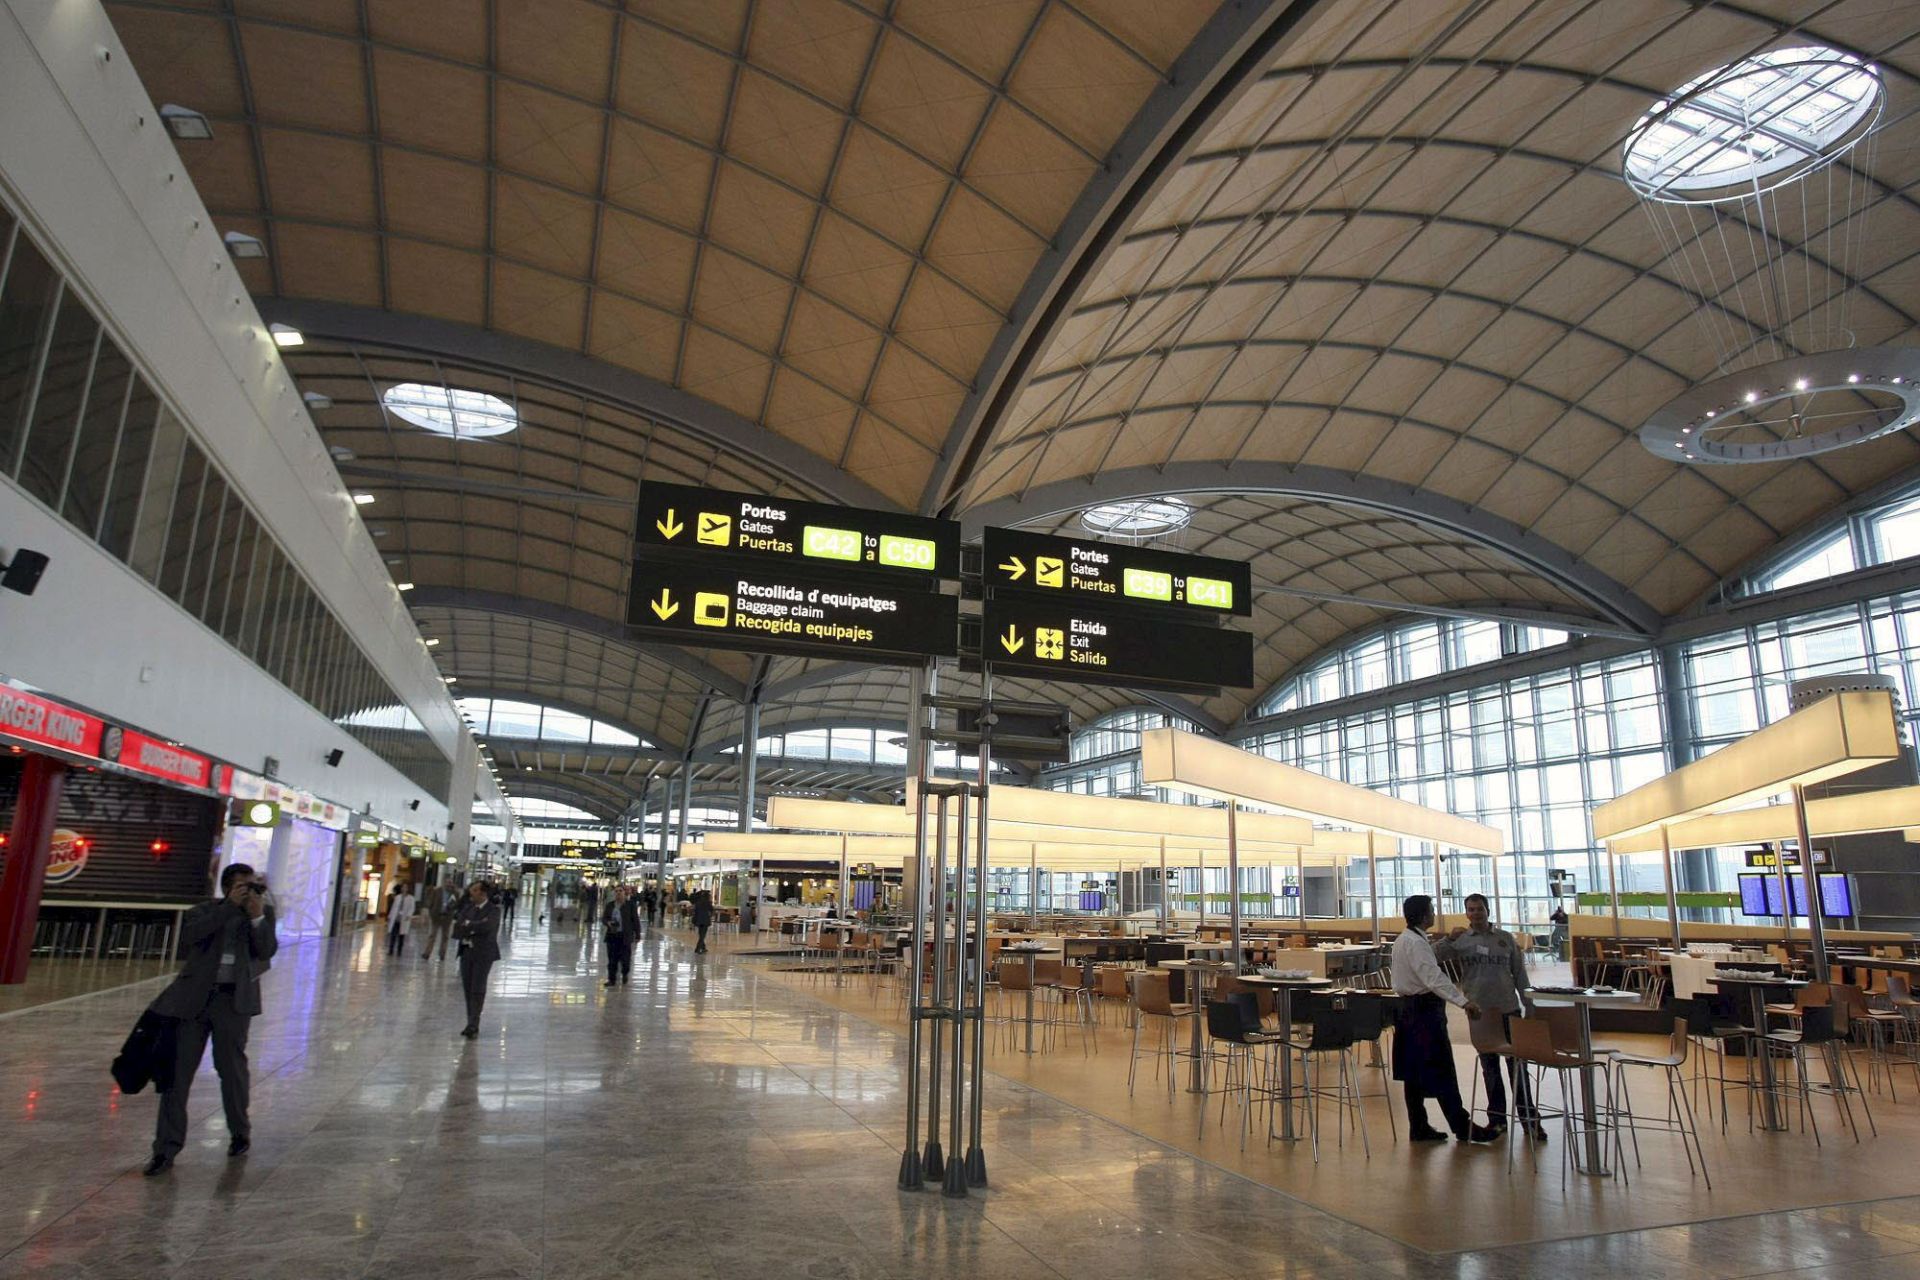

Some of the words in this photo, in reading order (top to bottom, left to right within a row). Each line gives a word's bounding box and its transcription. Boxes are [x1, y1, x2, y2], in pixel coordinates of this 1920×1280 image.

[741, 502, 787, 522] Portes
[739, 519, 774, 535] Gates
[739, 534, 793, 553] Puertas
[809, 531, 856, 556] C42
[864, 534, 878, 548] to
[886, 541, 932, 565] C50
[865, 550, 875, 561] a
[1071, 547, 1109, 564] Portes
[1070, 562, 1100, 577] Gates
[737, 580, 804, 602] Recollida
[1071, 576, 1117, 594] Puertas
[1129, 574, 1168, 596] C39
[1174, 577, 1185, 588] to
[1192, 582, 1227, 604] C41
[1176, 591, 1184, 600] a
[736, 598, 788, 617] Baggage
[791, 604, 824, 619] claim
[735, 613, 801, 634] Recogida
[805, 623, 873, 642] equipajes
[1070, 619, 1107, 636] Eixida
[1070, 635, 1090, 648] Exit
[1070, 649, 1107, 666] Salida
[0, 693, 45, 736] RGER
[46, 711, 87, 745] KING
